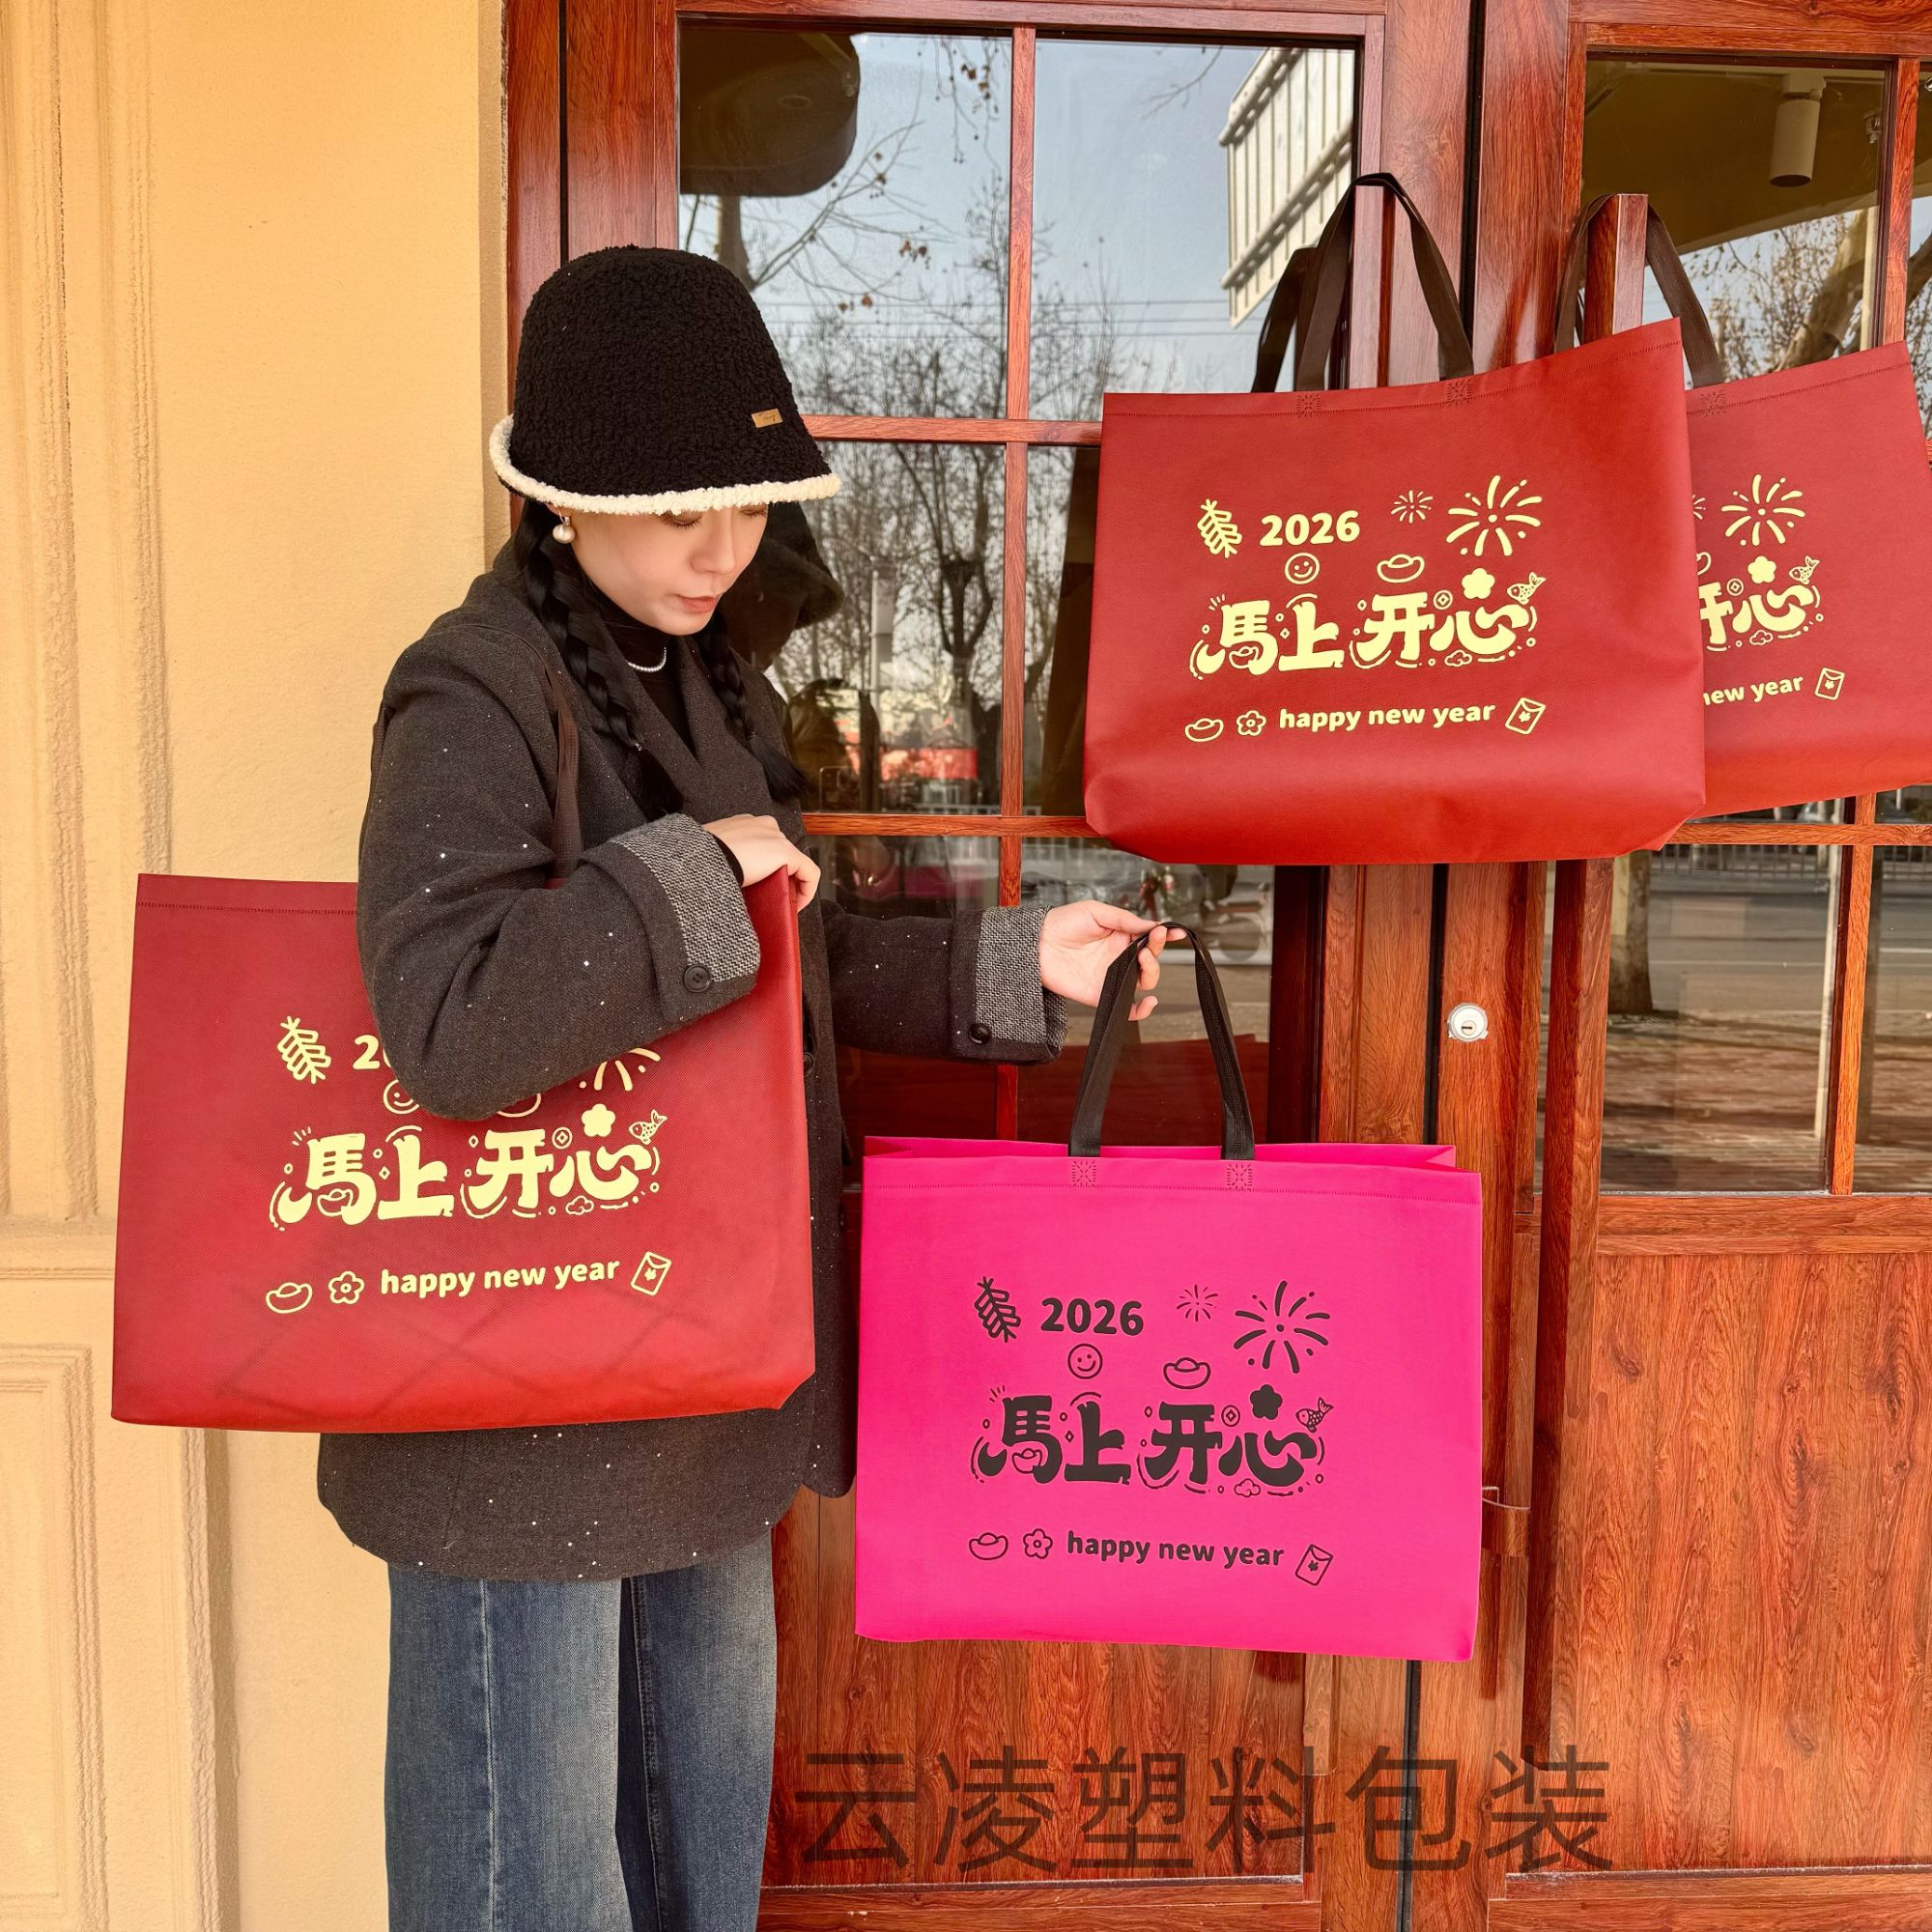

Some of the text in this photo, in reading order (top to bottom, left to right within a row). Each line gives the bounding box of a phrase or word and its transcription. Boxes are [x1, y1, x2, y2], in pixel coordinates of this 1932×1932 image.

[1259, 509, 1360, 547] 2026
[1196, 591, 1530, 675] 馬上开心
[1749, 676, 1804, 703] year
[1279, 704, 1496, 733] happy new year
[276, 1128, 652, 1226] 馬上开心
[381, 1260, 620, 1299] happy new year
[1040, 1297, 1144, 1337] 2026
[977, 1395, 1318, 1488] 馬上开心
[1067, 1530, 1284, 1570] happy new year
